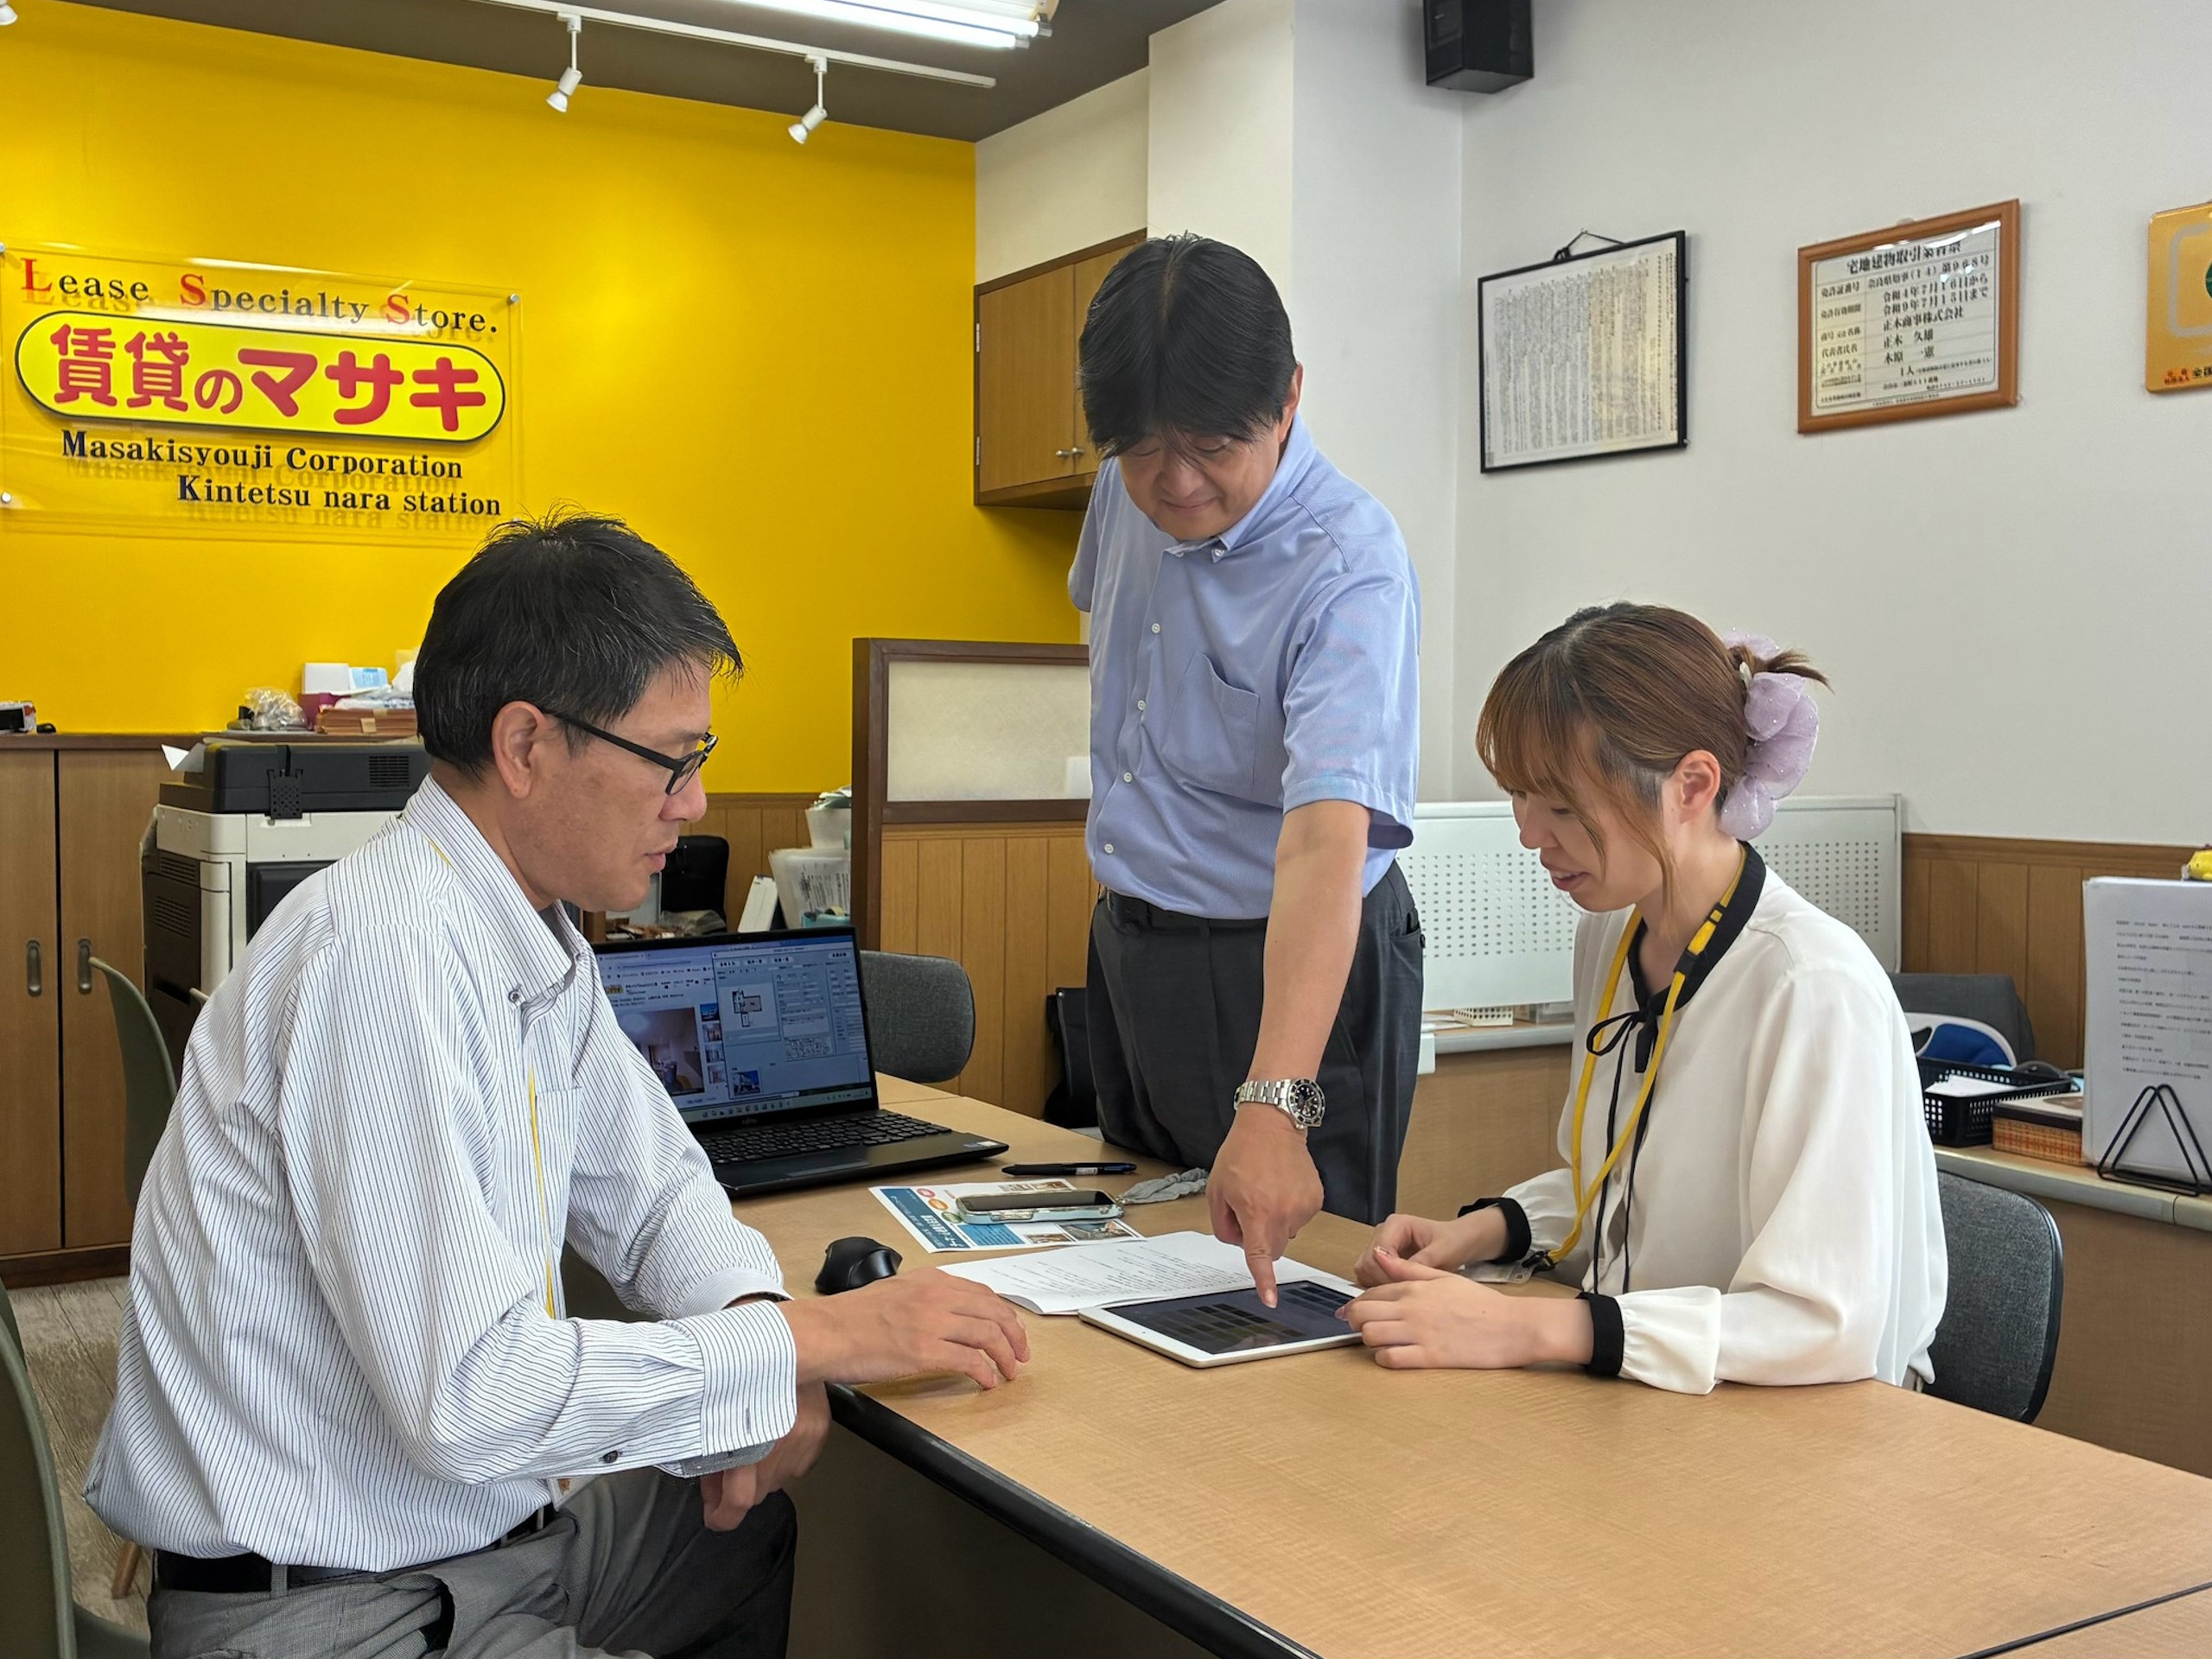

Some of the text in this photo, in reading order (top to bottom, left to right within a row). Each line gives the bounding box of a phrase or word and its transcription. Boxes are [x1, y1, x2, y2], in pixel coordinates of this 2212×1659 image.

[21, 257, 499, 334] Lease Specialty Store.
[50, 323, 486, 431] 賃貸のマサキ
[61, 429, 462, 480] Masakisyouji Corporation
[177, 474, 501, 516] Kintetsu nara station
